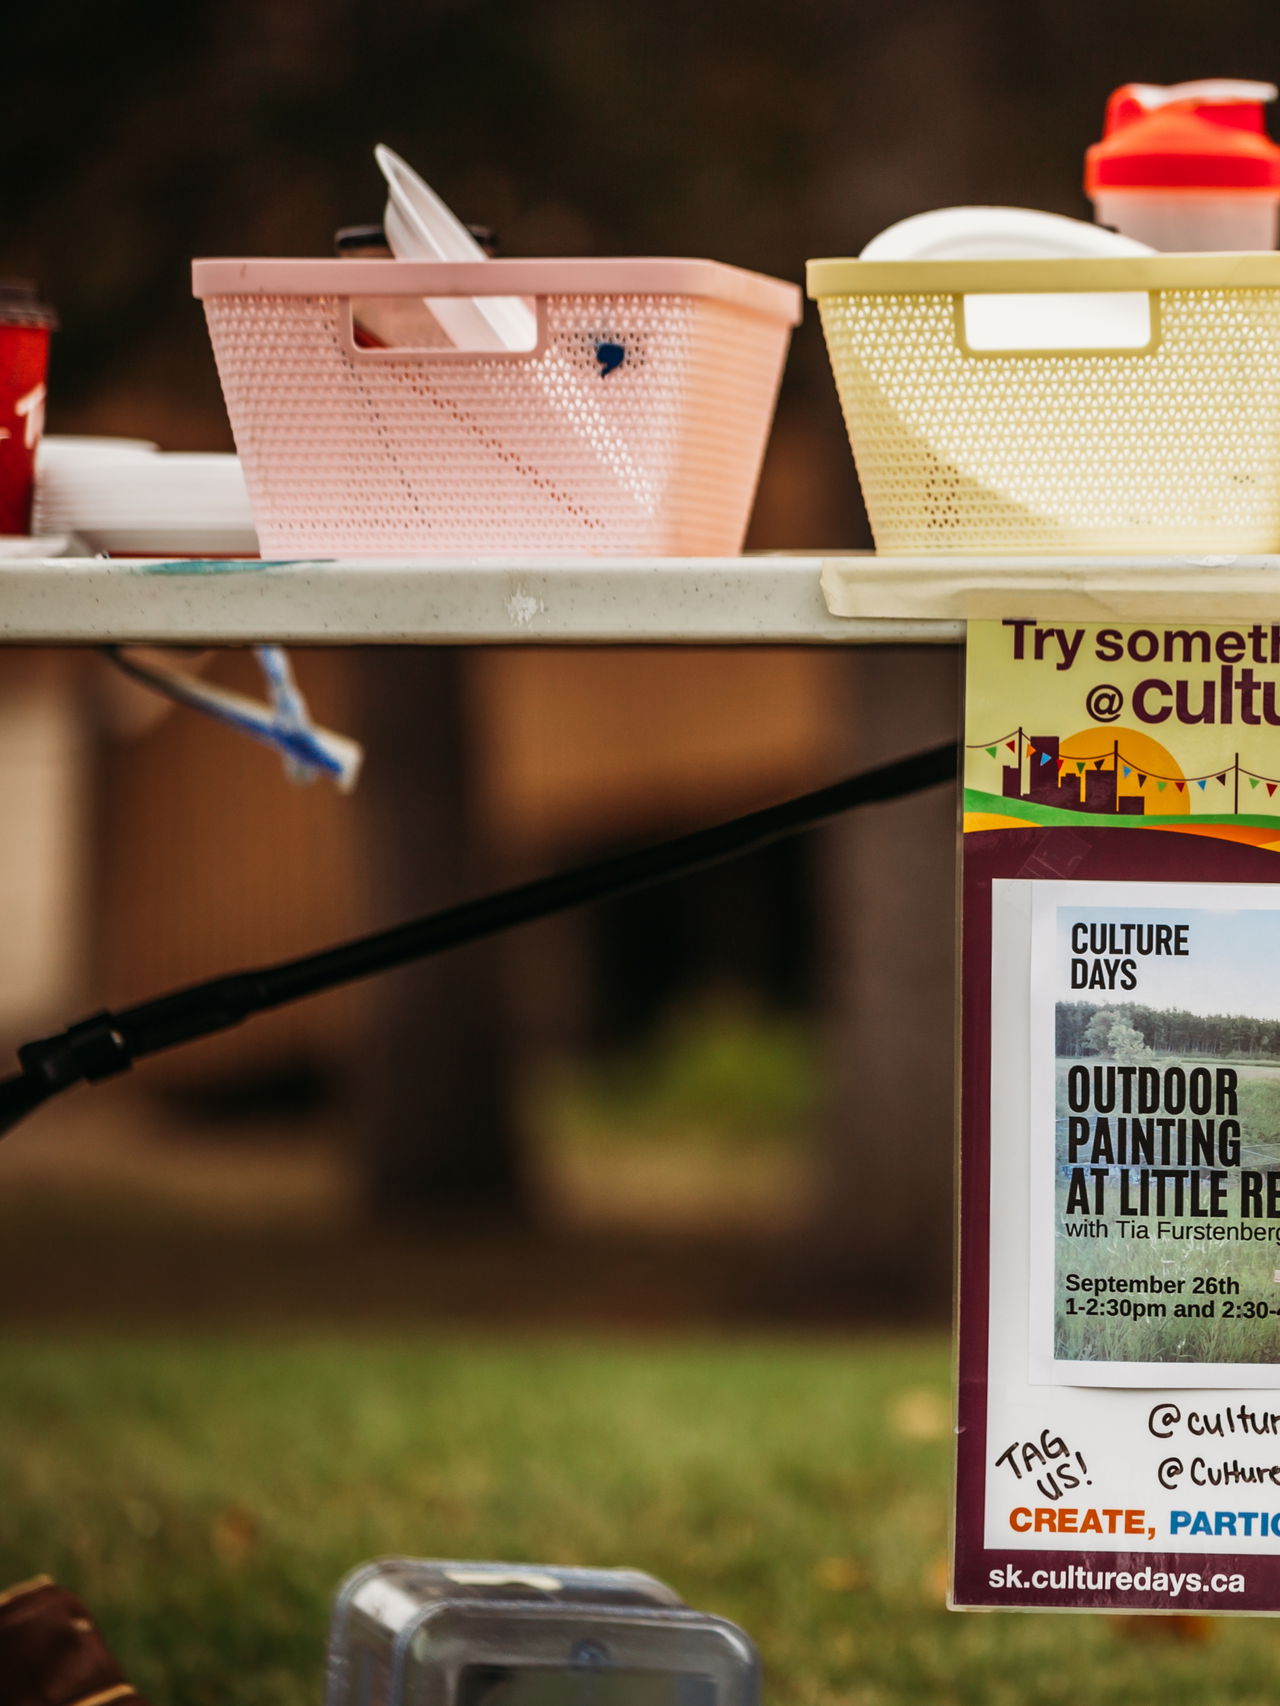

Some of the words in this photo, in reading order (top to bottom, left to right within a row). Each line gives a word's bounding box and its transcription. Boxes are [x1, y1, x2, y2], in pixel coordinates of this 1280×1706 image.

[1002, 619, 1085, 671] Try
[1071, 922, 1190, 956] CULTURE
[1070, 958, 1138, 991] DAYS
[1068, 1065, 1239, 1116] OUTDOOR
[1068, 1116, 1241, 1167] PAINTING
[1066, 1168, 1109, 1215] AT
[1120, 1169, 1228, 1218] LITTLE
[1065, 1219, 1108, 1238] with
[1115, 1220, 1150, 1239] Tia
[1065, 1273, 1186, 1297] September
[1192, 1276, 1240, 1295] 26th
[1065, 1298, 1167, 1321] 1-2:30pm
[1174, 1301, 1215, 1318] and
[995, 1429, 1070, 1479] TAG
[1036, 1451, 1092, 1501] US!
[1009, 1506, 1156, 1541] CREATE,
[988, 1564, 1246, 1597] sk.culturedays.ca
